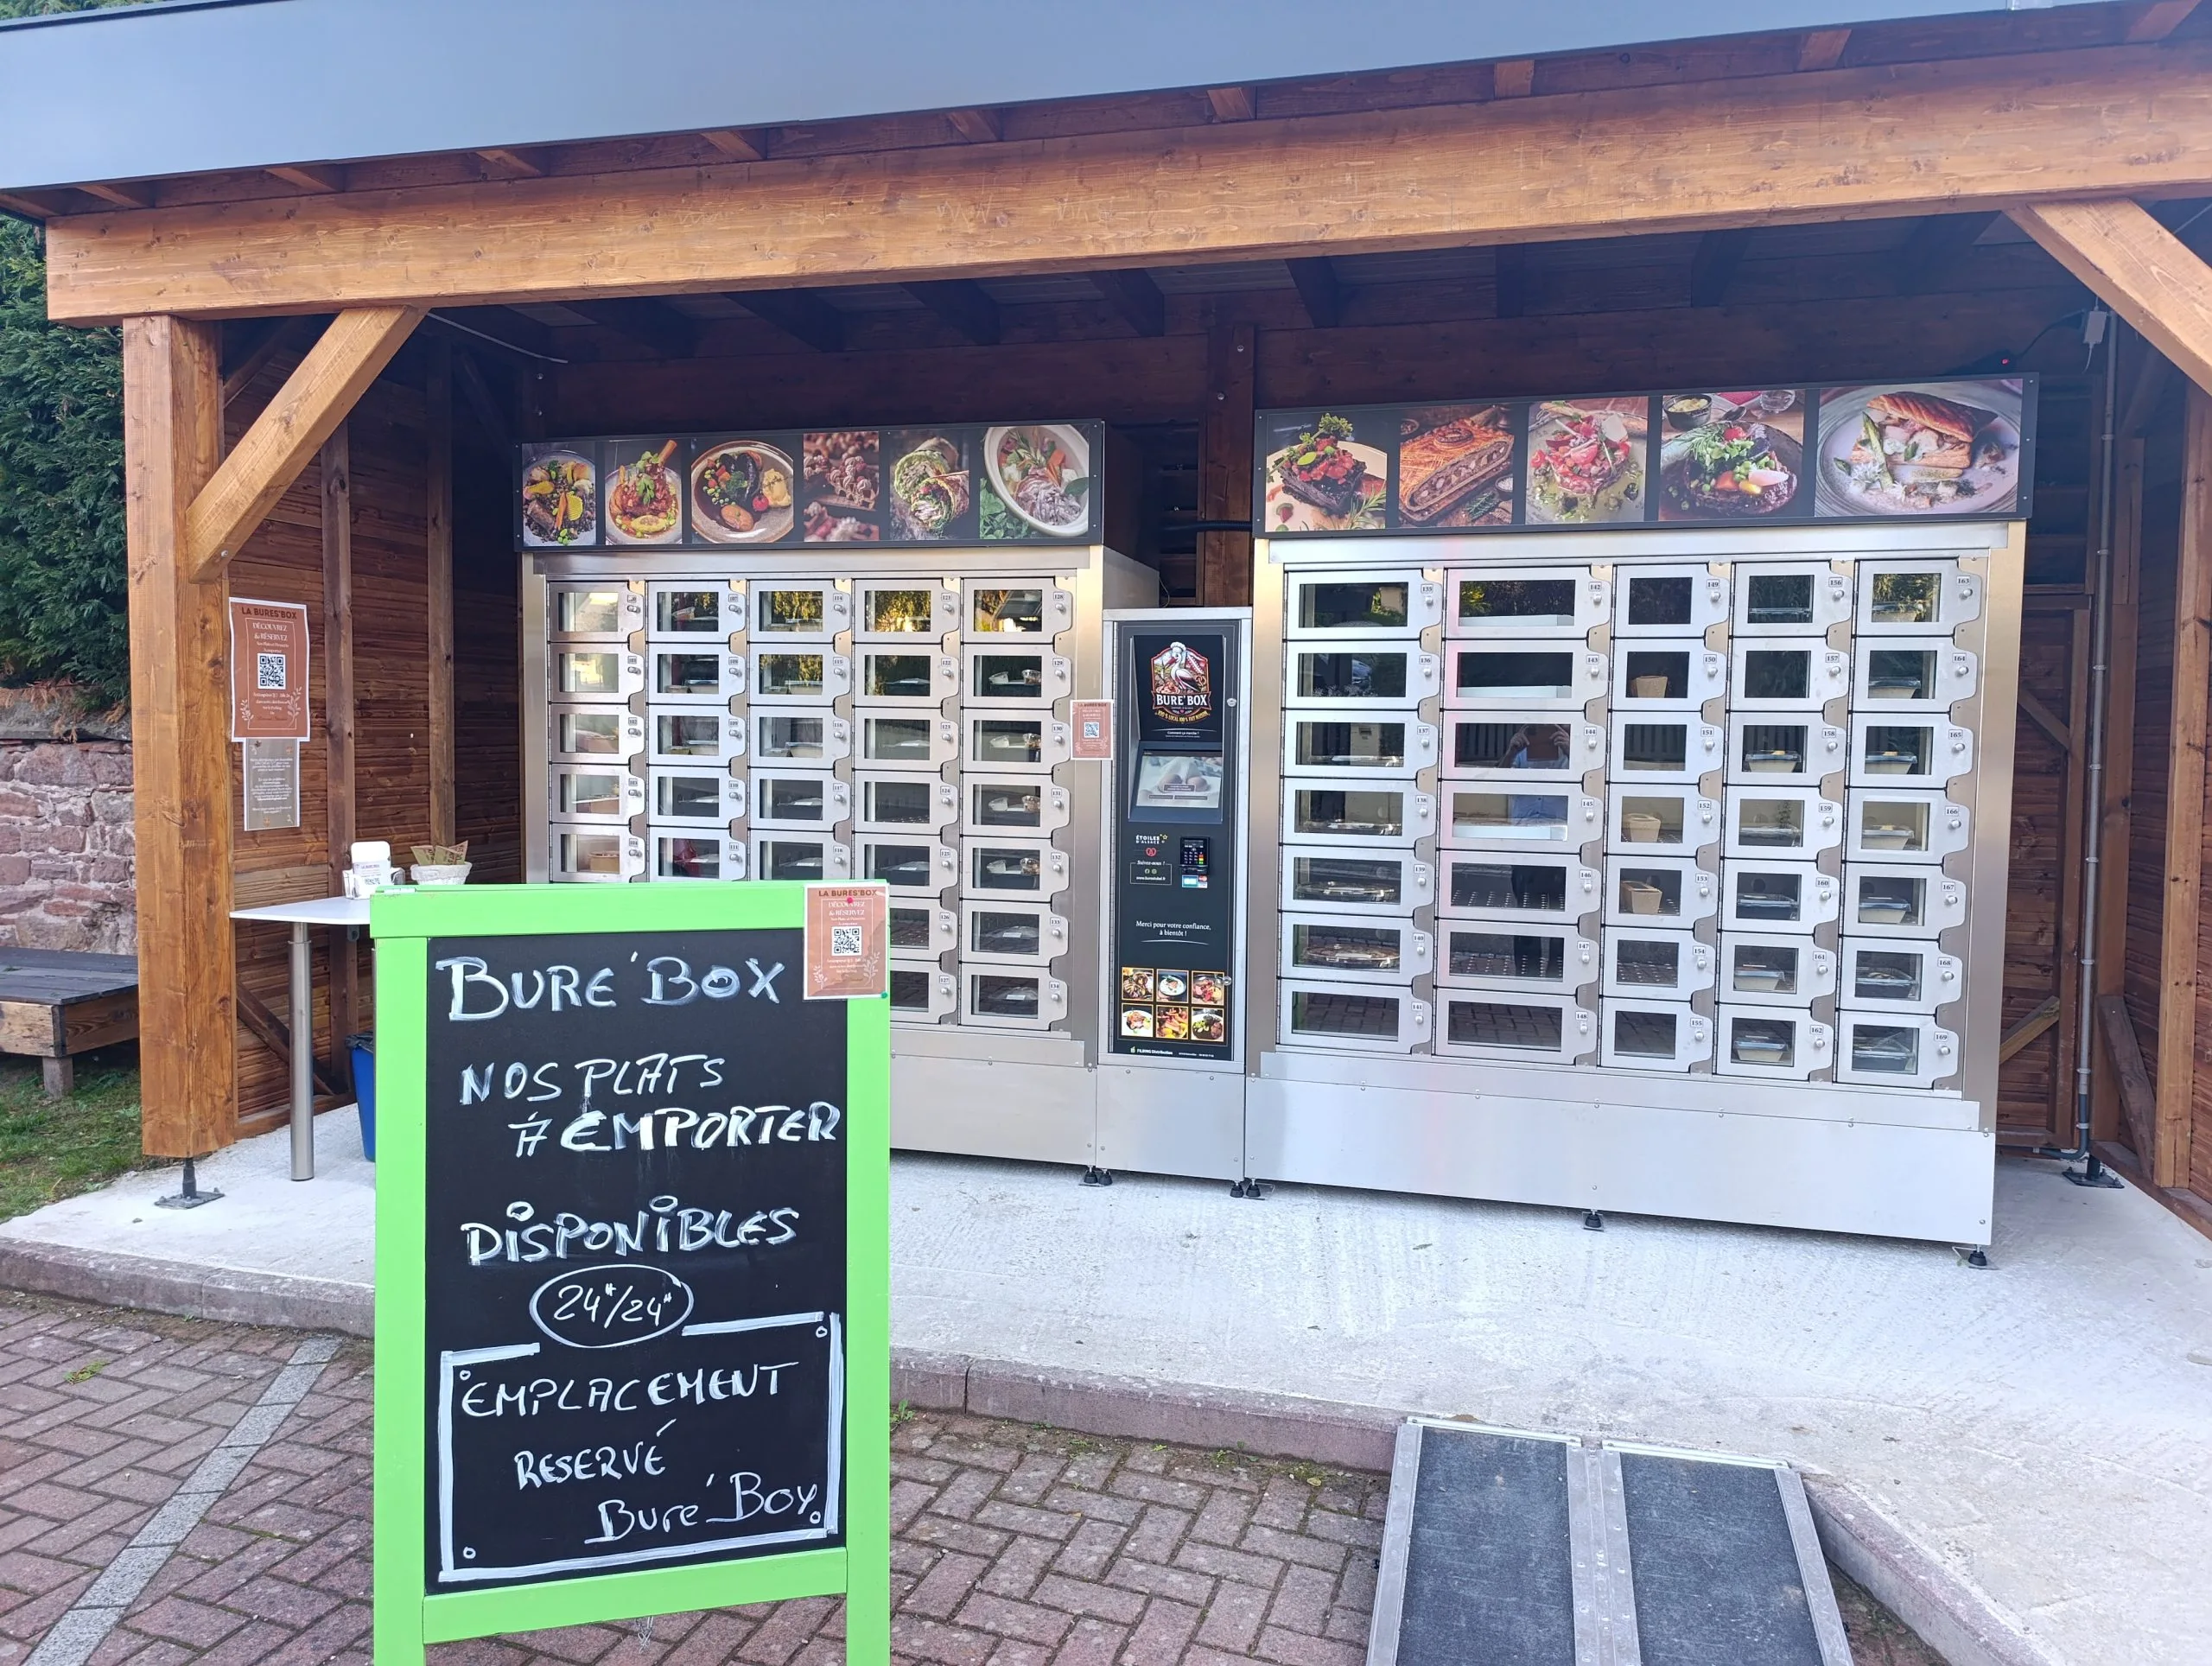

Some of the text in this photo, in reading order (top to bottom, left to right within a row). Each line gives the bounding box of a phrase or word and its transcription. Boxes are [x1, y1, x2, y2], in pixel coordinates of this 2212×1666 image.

[242, 607, 297, 620] LA BURES'BOX
[1182, 922, 1211, 931] confiance,
[460, 1052, 726, 1105] NOS PLATS
[560, 1102, 841, 1151] EMPORTER
[461, 1361, 800, 1417] EMPLACEMENT
